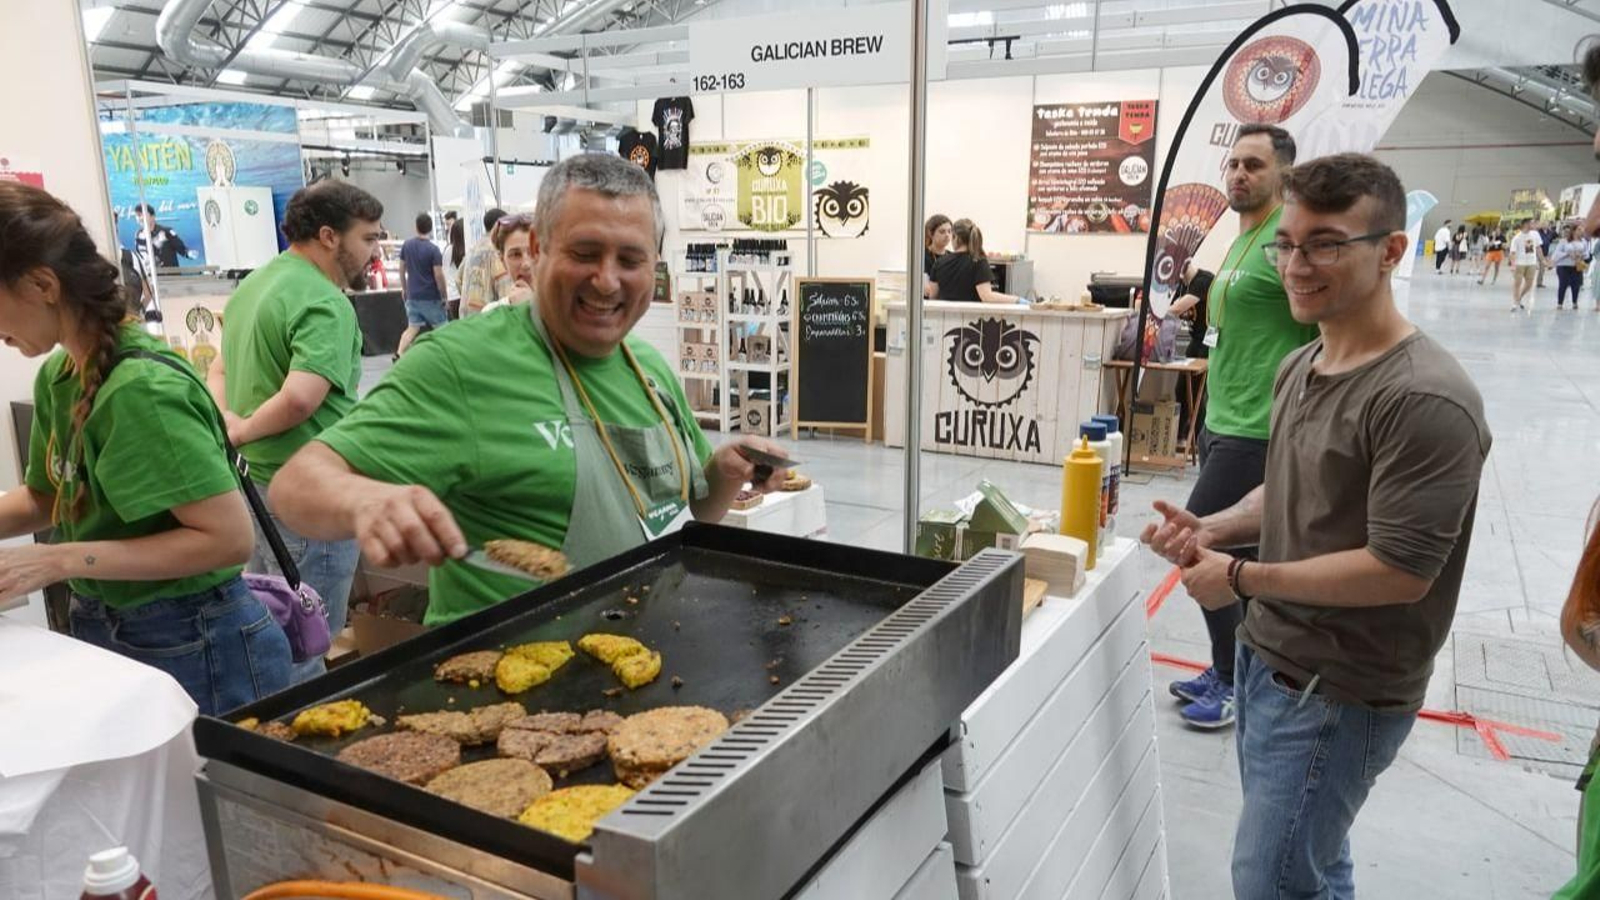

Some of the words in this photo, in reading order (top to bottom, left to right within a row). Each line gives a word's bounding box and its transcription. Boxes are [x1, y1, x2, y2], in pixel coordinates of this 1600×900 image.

[751, 40, 827, 62] GALICIAN
[831, 35, 884, 56] BREW
[693, 73, 746, 91] 162-163
[751, 195, 788, 224] BIO
[935, 410, 1041, 453] CURUXA
